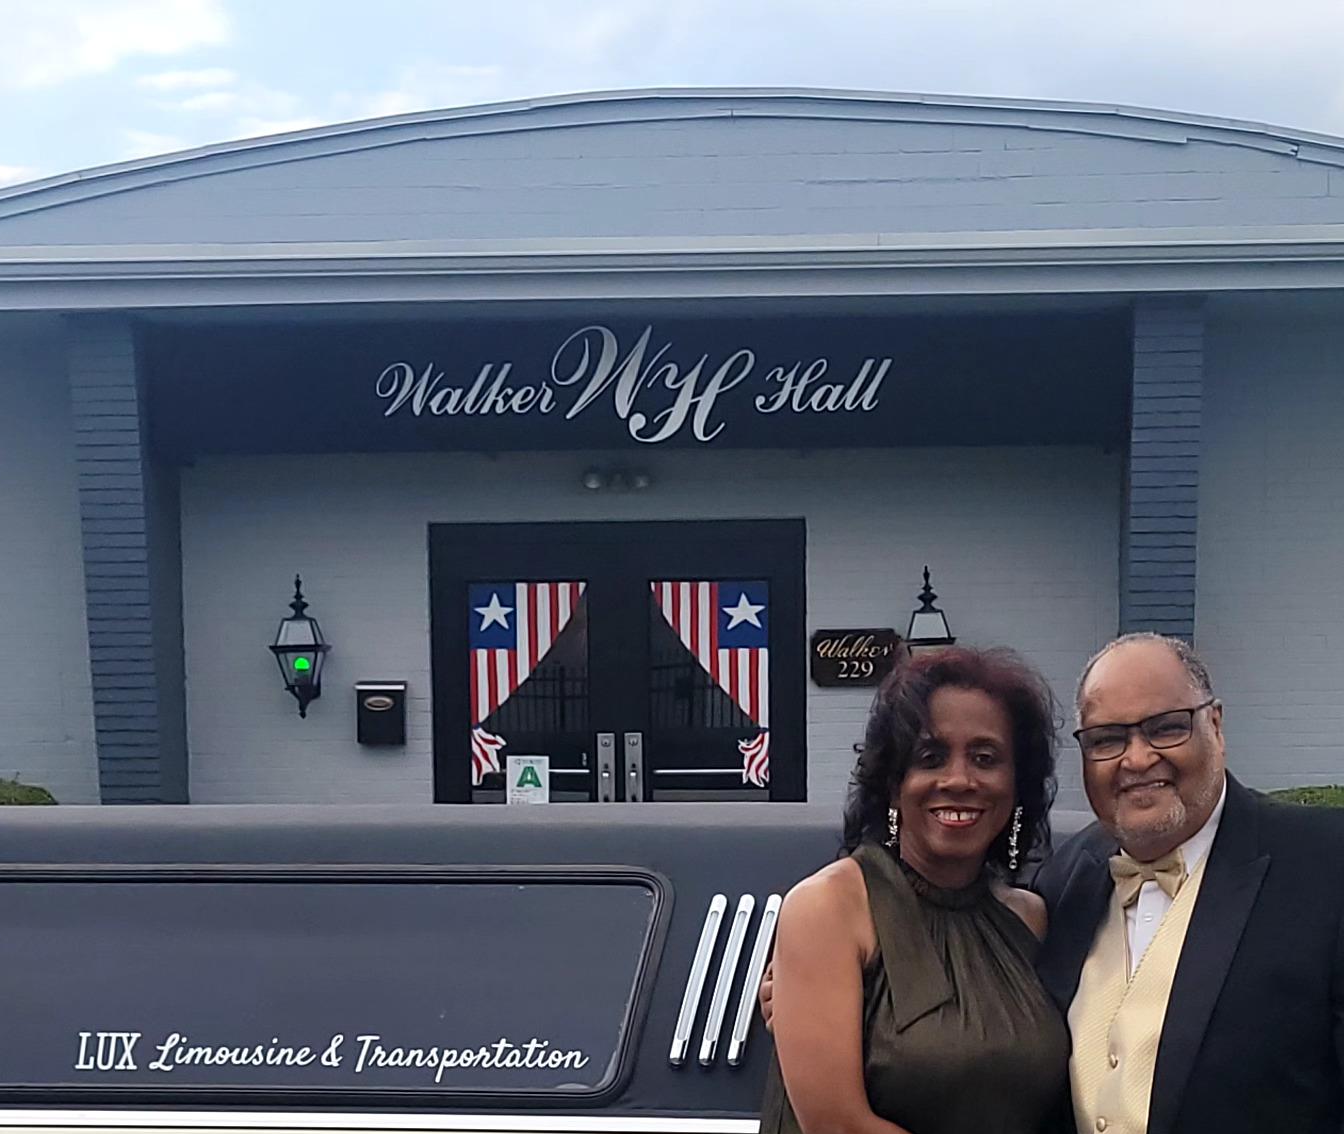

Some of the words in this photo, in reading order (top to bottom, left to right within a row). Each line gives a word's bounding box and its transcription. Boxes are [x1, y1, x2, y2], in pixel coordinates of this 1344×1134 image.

[375, 361, 556, 418] Walker
[551, 324, 755, 443] WH
[755, 357, 893, 415] Hall
[837, 660, 874, 678] 229
[516, 766, 542, 787] A
[75, 1031, 142, 1071] LUX
[149, 1033, 317, 1072] Limousine
[320, 1034, 344, 1067] &
[355, 1035, 590, 1083] Transportation
